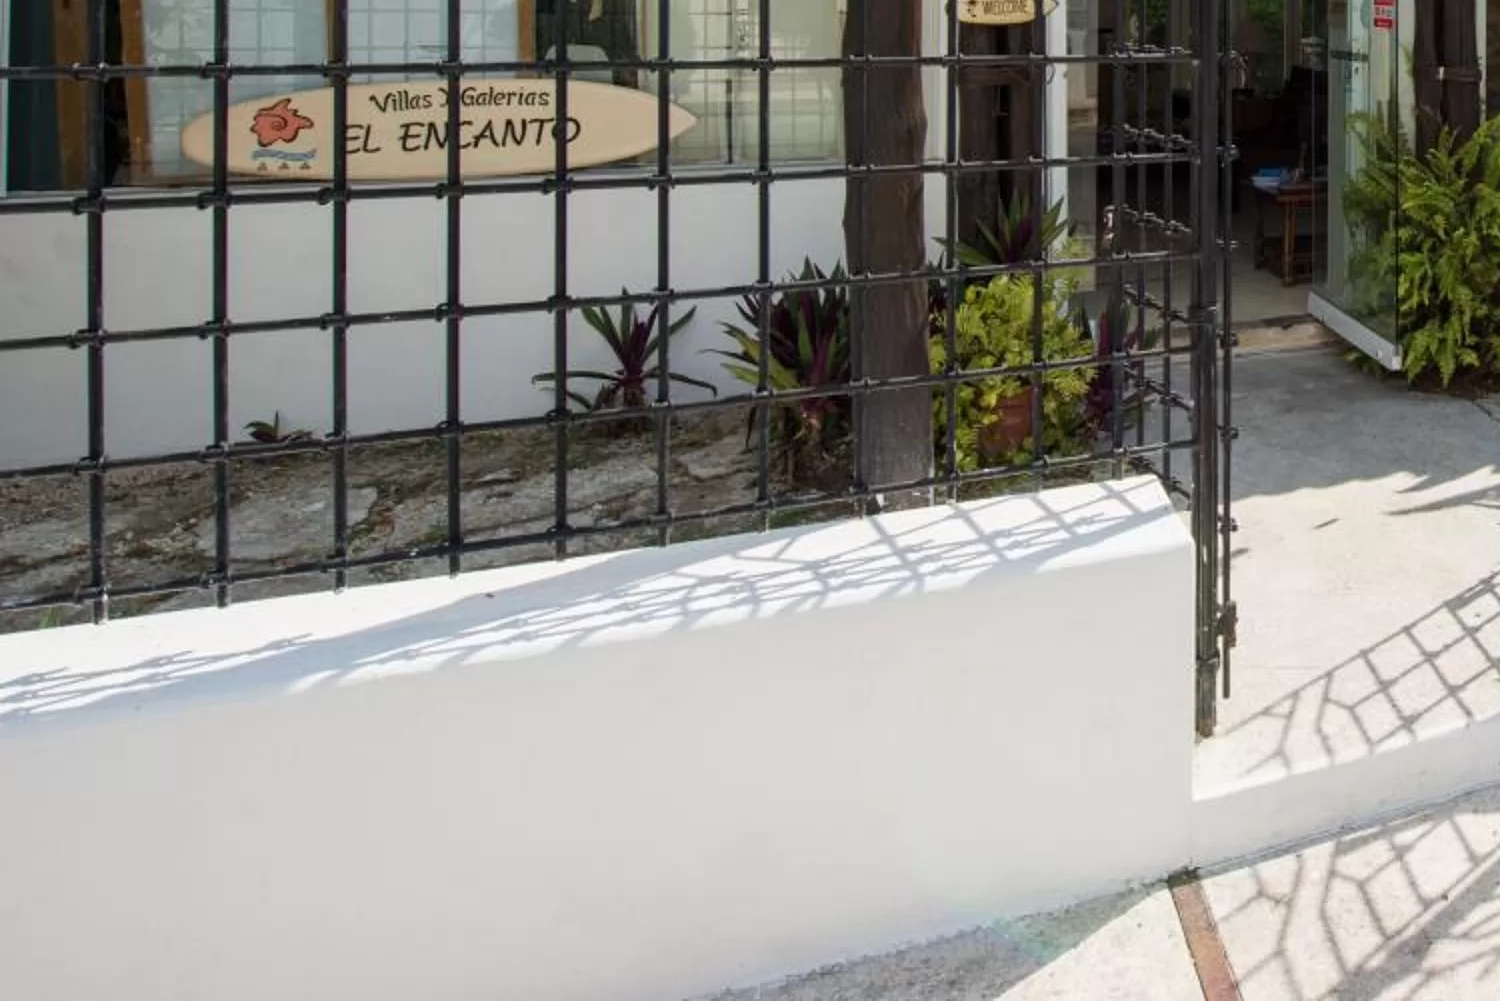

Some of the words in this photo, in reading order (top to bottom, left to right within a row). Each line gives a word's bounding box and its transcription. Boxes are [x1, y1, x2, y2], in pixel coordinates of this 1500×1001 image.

[369, 89, 433, 114] Villas
[460, 86, 550, 107] Galerias
[343, 123, 381, 154] EL
[398, 117, 582, 153] ENCANTO
